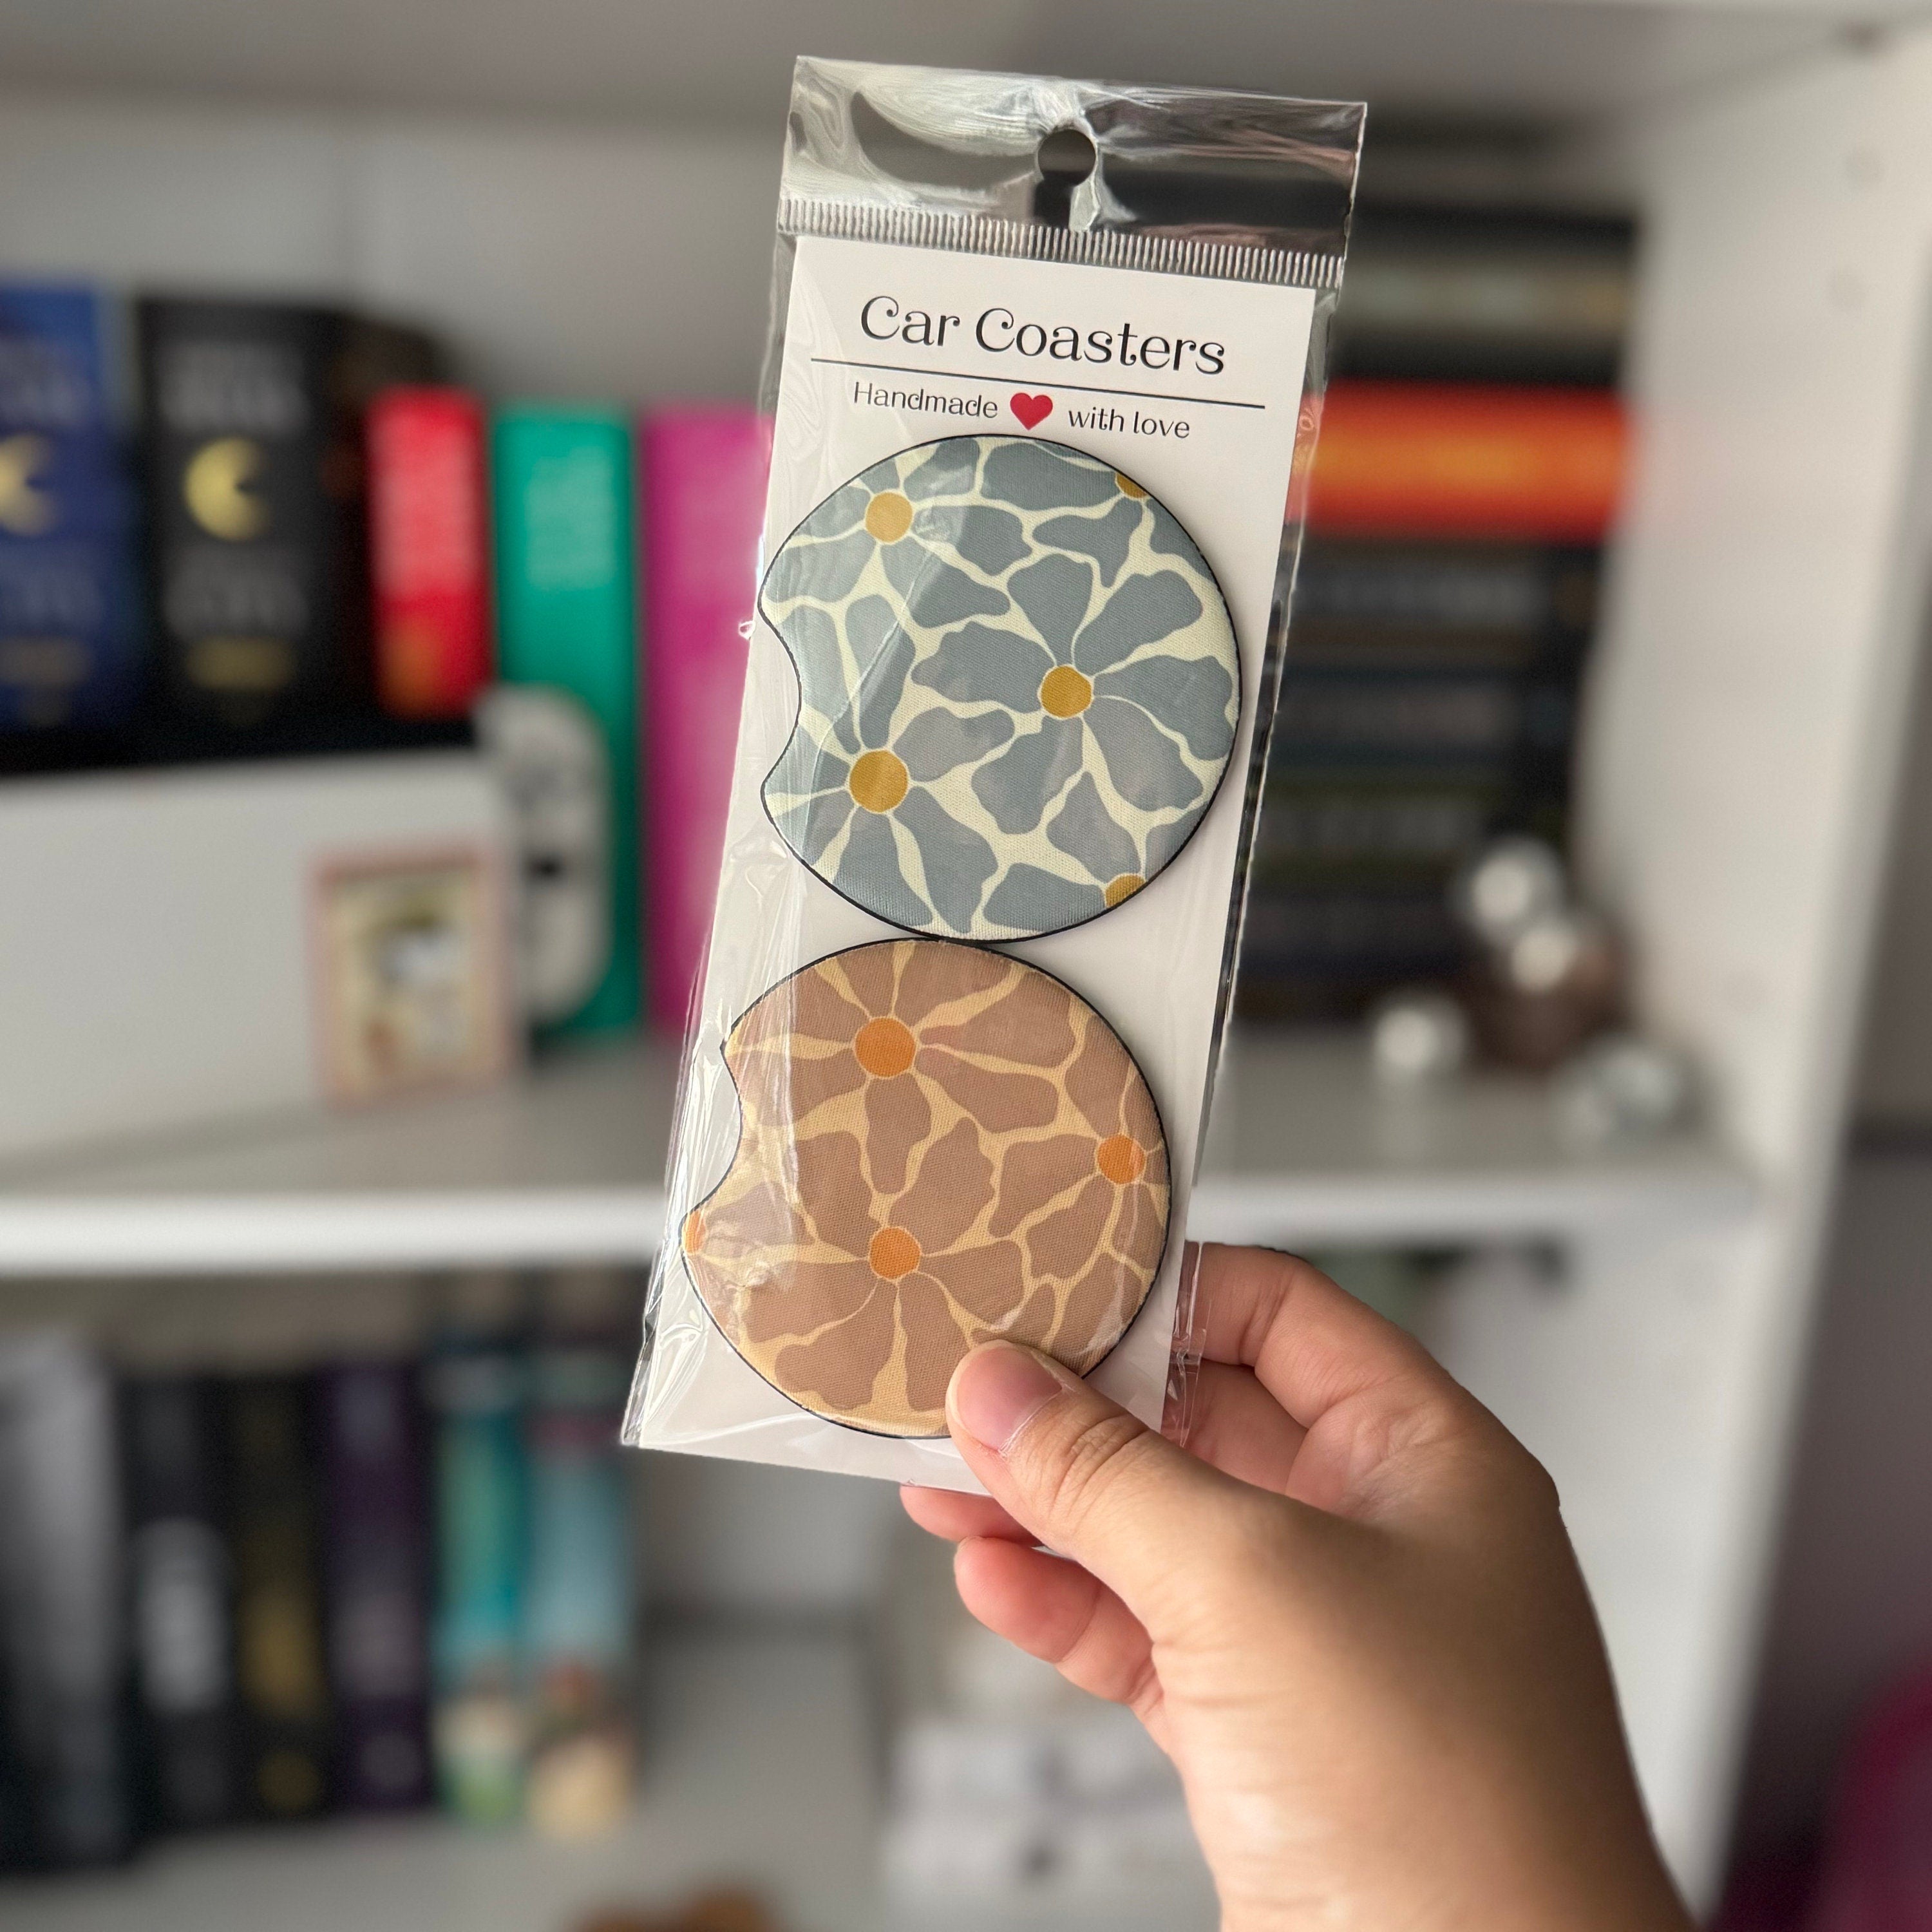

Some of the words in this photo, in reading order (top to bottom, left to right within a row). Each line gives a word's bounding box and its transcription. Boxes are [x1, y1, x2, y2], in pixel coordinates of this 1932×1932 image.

[860, 296, 960, 346] Car
[976, 308, 1225, 375] Coasters
[853, 381, 998, 419] Handmade
[1068, 406, 1124, 432] with
[1133, 410, 1190, 439] love
